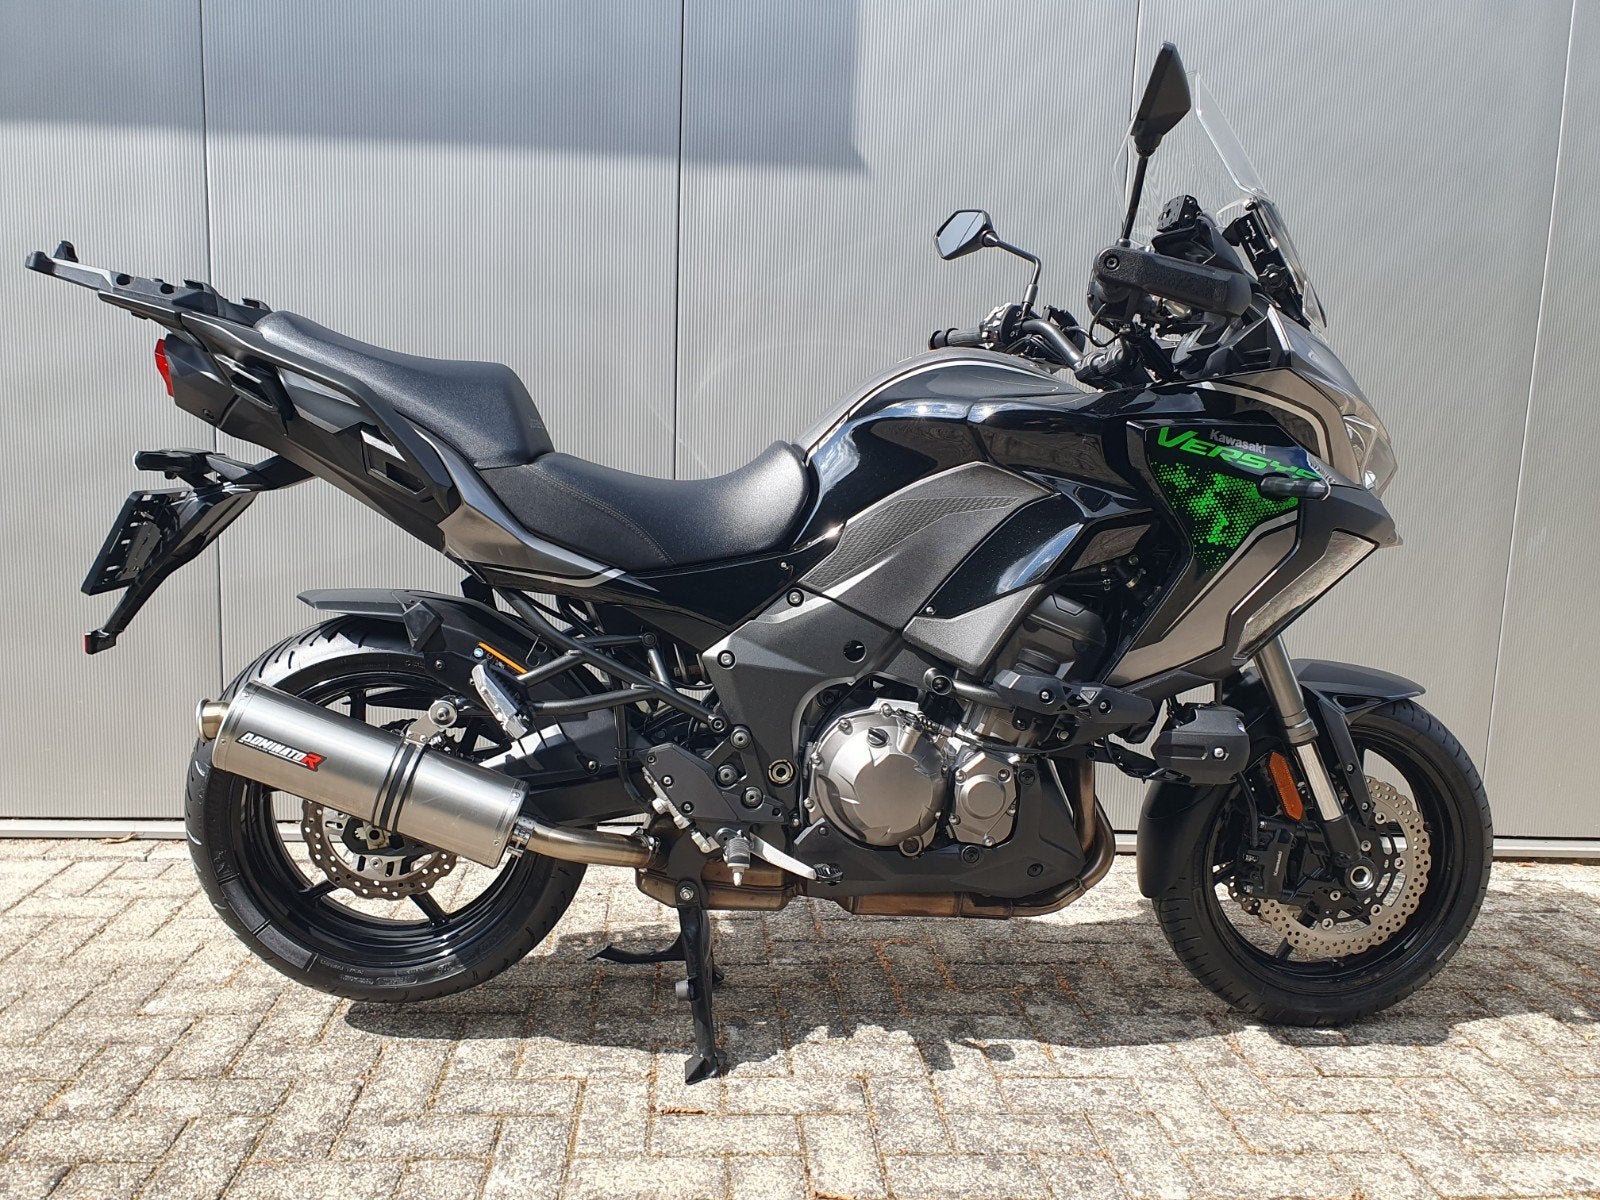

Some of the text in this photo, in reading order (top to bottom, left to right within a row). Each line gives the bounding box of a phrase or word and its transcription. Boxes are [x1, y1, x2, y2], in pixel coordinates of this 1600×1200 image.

[1157, 426, 1322, 480] VERSYS
[1210, 429, 1266, 455] Kawasaki
[240, 732, 323, 769] DOMINATOR
